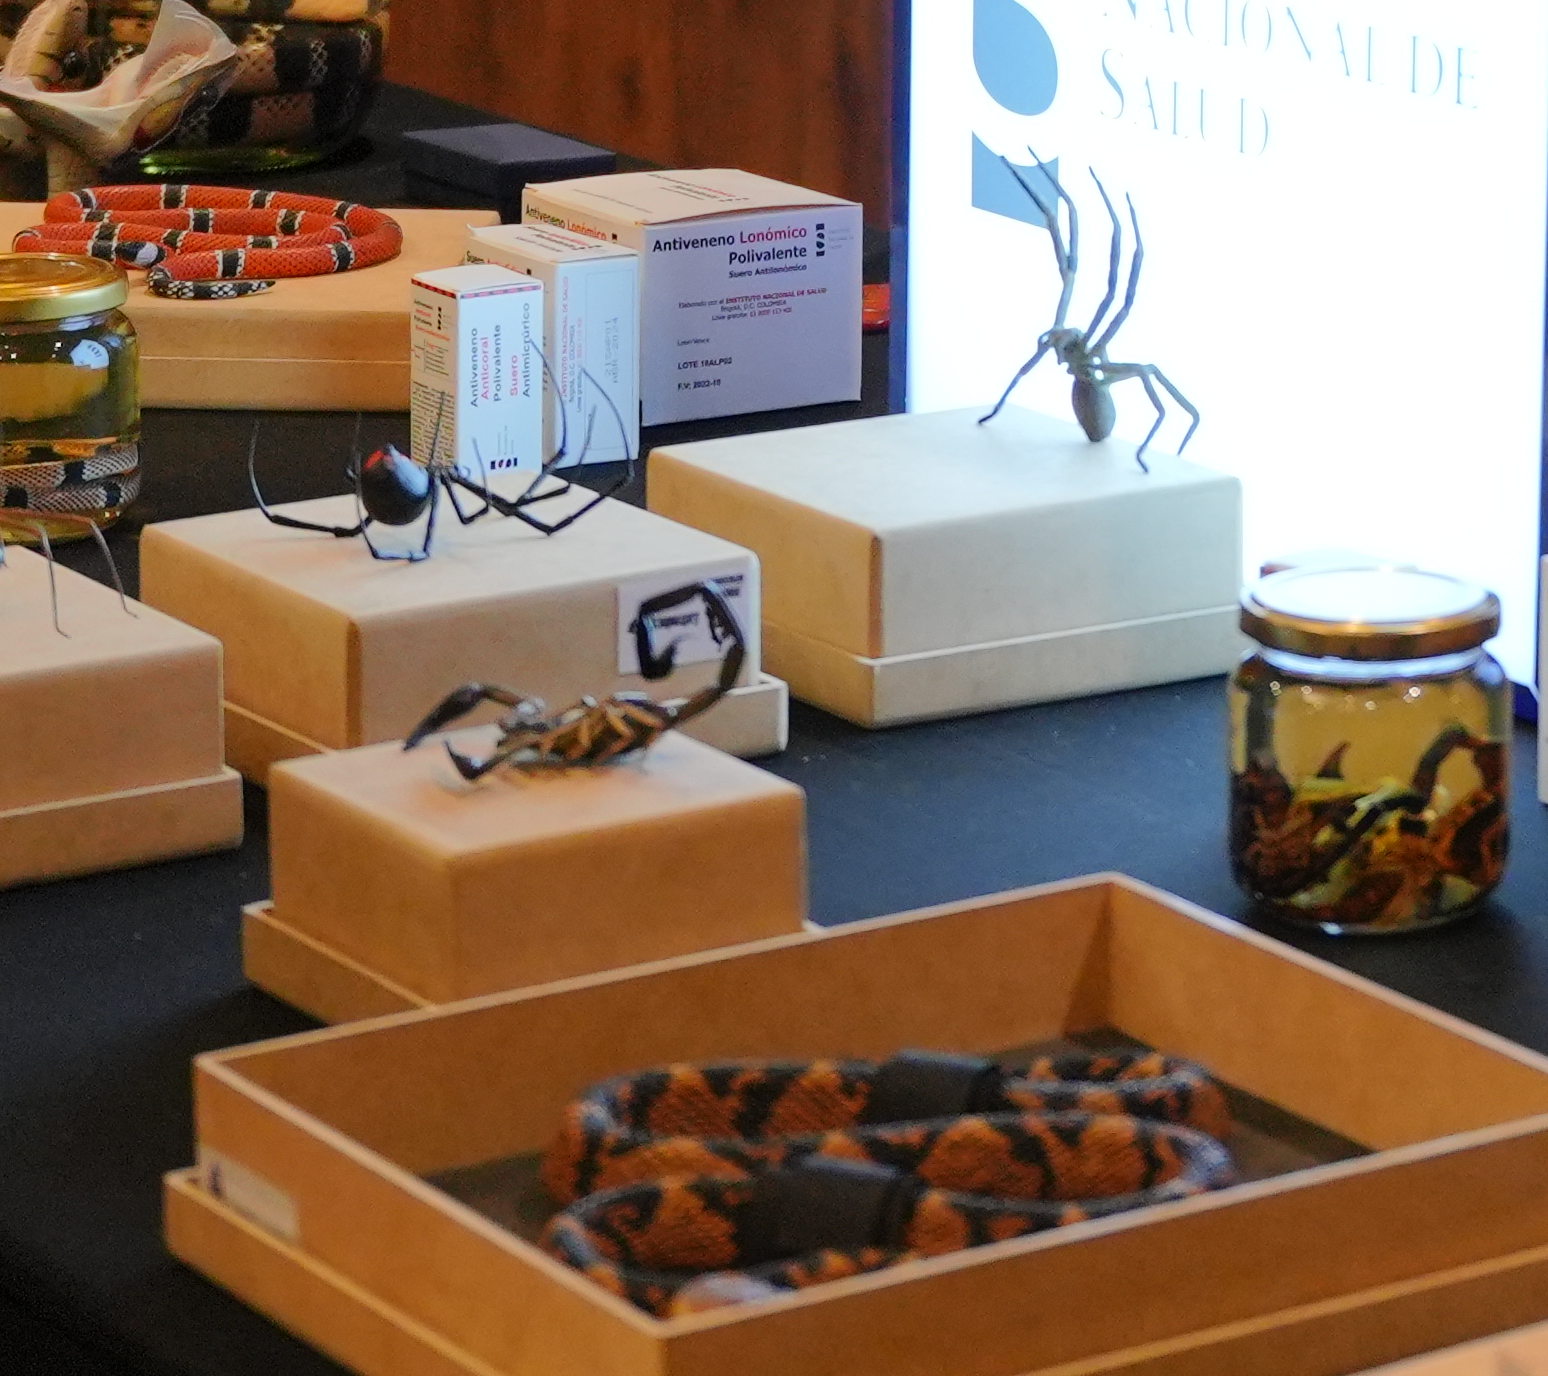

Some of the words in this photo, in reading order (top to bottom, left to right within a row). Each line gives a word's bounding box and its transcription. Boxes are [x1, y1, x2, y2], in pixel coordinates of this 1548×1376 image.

[1100, 48, 1270, 155] SALUD
[1409, 35, 1479, 108] DE
[652, 234, 735, 253] Antiveneno
[739, 226, 808, 244] Lonómico
[728, 245, 808, 265] Polivalente
[728, 269, 753, 279] Suero
[470, 327, 479, 408] Antiveneno
[480, 337, 489, 400] Anticoral
[493, 324, 502, 402] Polivalente
[509, 354, 519, 396] Suero
[521, 302, 531, 398] Antimicrúrico
[677, 360, 699, 370] LOTE
